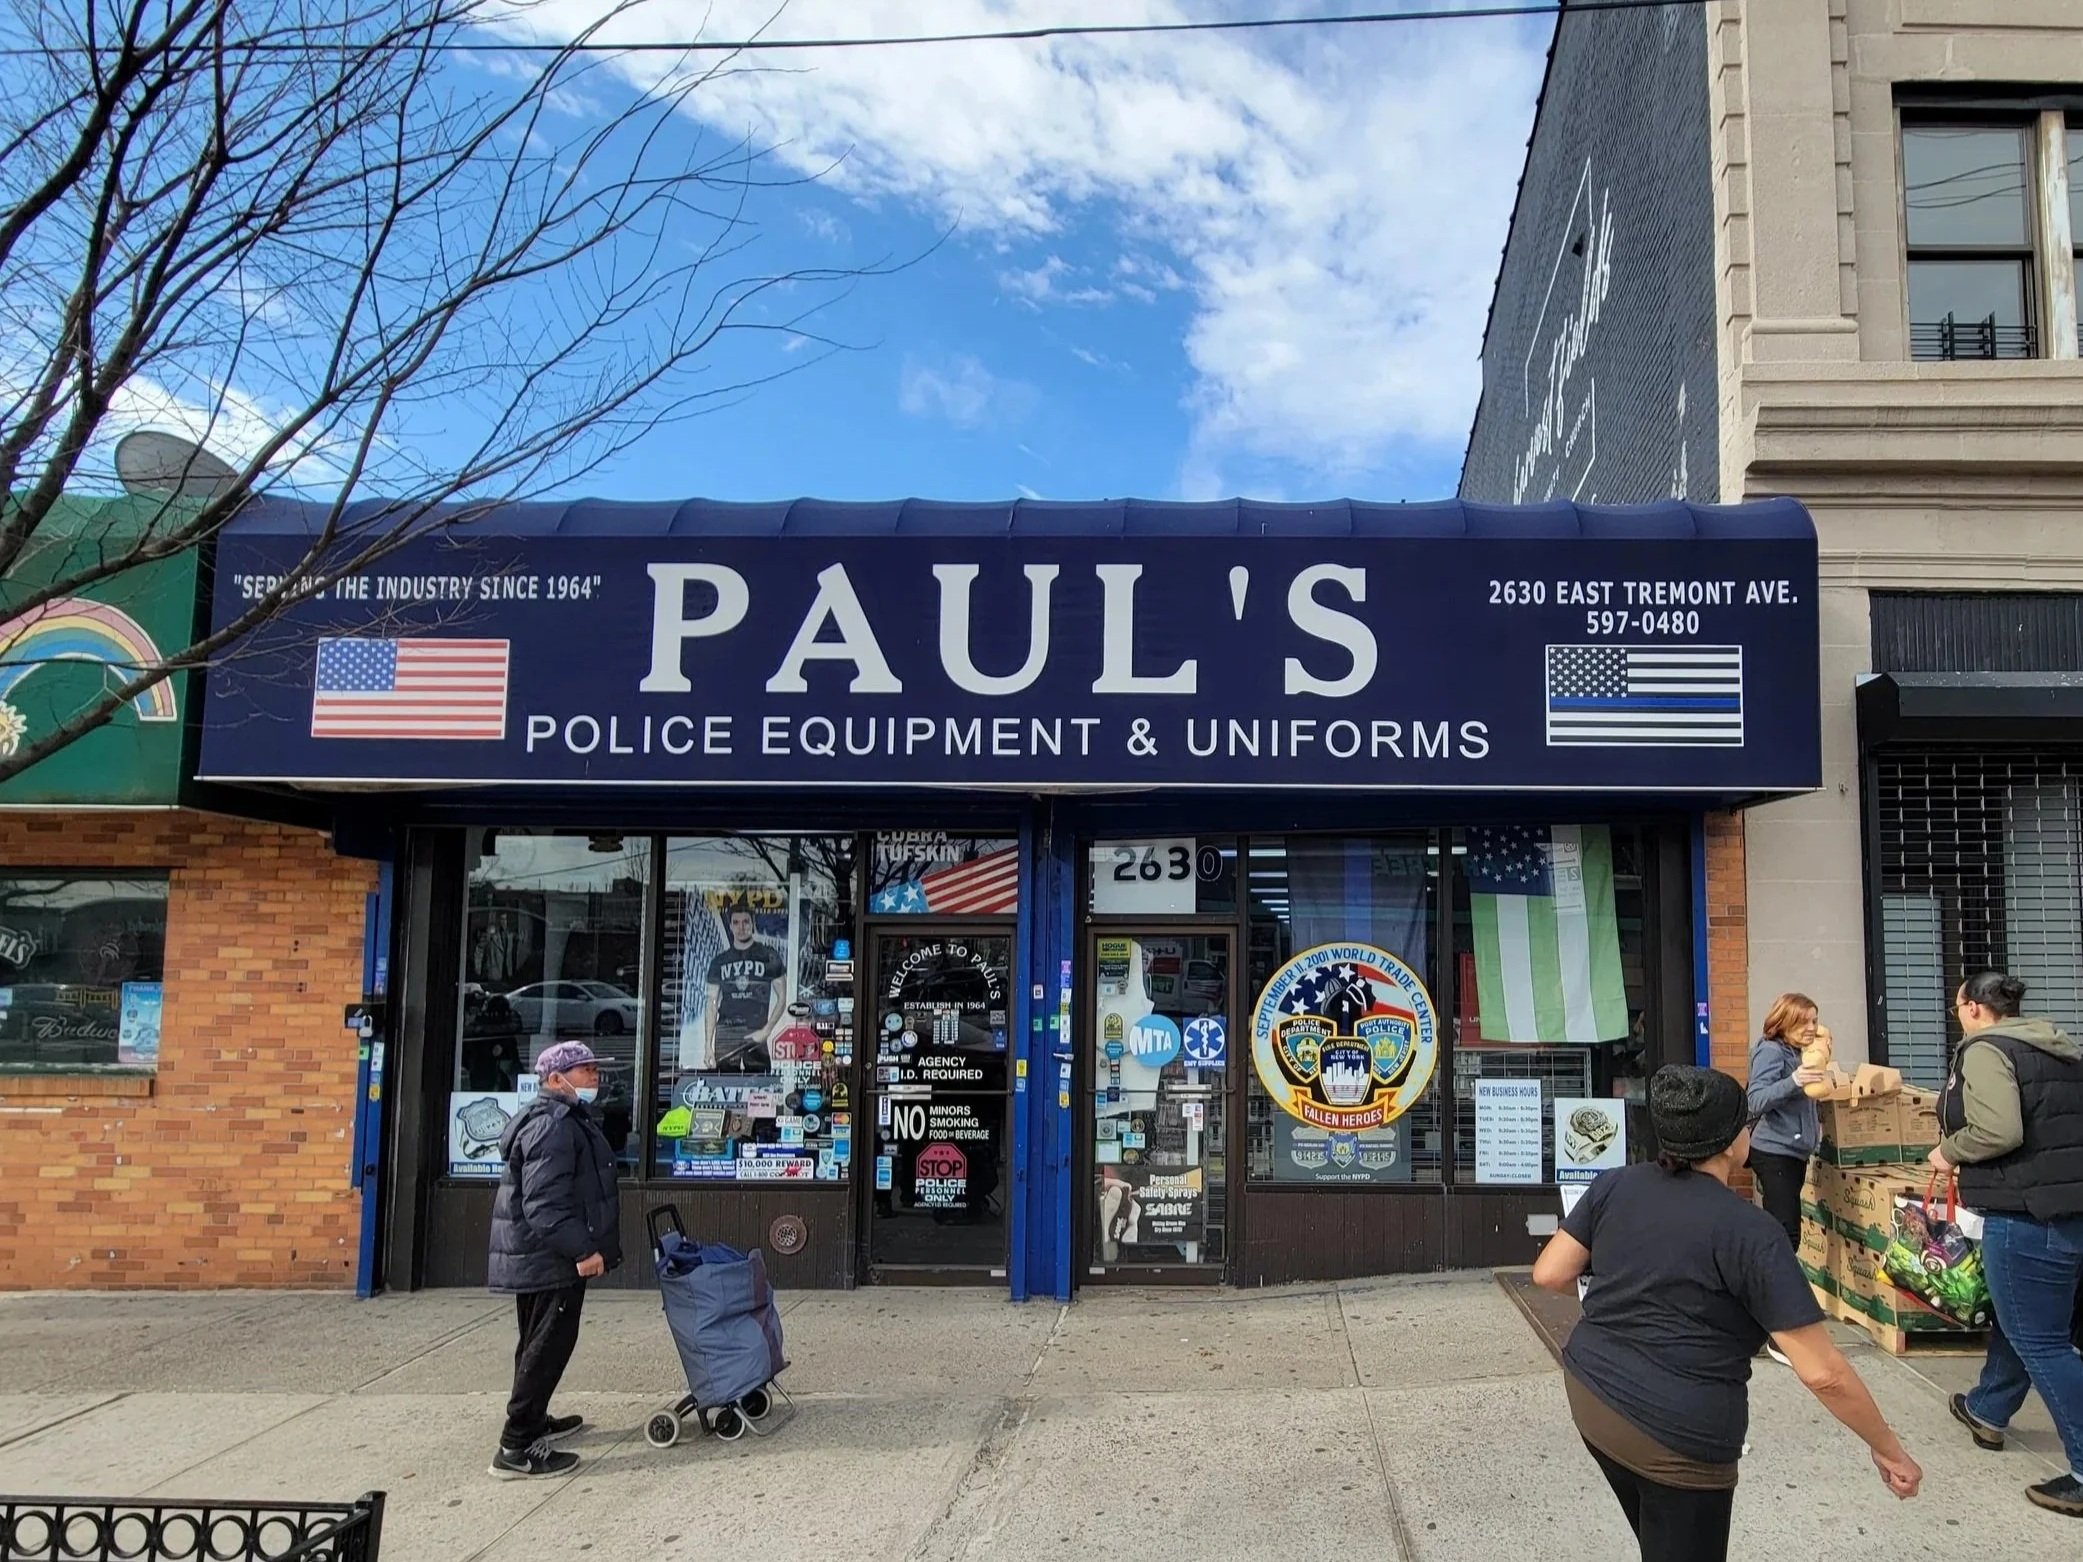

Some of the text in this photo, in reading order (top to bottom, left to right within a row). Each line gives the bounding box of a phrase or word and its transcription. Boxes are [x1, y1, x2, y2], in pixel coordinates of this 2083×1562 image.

[1566, 392, 1591, 458] CHURCH
[233, 574, 601, 600] "SERNG THE INDUSTRY SINCE 1964"
[1489, 580, 1798, 605] 2630 EAST TREMONT AVE.
[1587, 610, 1700, 635] 597-0480
[639, 562, 1379, 698] PAUL'S
[526, 715, 1491, 761] POLICE EQUIPMENT & UNIFORMS
[877, 831, 948, 842] COBRA
[1113, 845, 1223, 882] 2630
[705, 889, 783, 909] NYPD
[720, 960, 765, 980] NYPD
[889, 944, 1001, 1000] WELCOME TO PAUL'S
[1257, 973, 1296, 1040] SEPTEMBER
[1332, 948, 1377, 965] WORLD
[1380, 956, 1417, 992] TRADE
[1411, 991, 1433, 1044] CENTER
[903, 1001, 986, 1010] ESTABLISH IN 1964
[1360, 1019, 1410, 1030] PORT AUTHORITY
[1366, 1026, 1405, 1035] POLICE
[1281, 1026, 1331, 1038] DEPARTMENT
[1130, 1025, 1172, 1056] MTA
[1322, 1041, 1370, 1052] FIRE DEPARTMENT
[1283, 1045, 1294, 1063] CITY
[918, 1056, 967, 1068] AGENCY
[901, 1069, 983, 1080] I.D. REQUIRED
[1479, 1087, 1538, 1097] NEW BUSINESS HOURS
[929, 1106, 971, 1115] MINORS
[1304, 1105, 1383, 1127] FALLEN HEROES
[894, 1105, 926, 1140] NO
[929, 1117, 979, 1127] SMOKING
[929, 1130, 947, 1140] FOOD
[955, 1130, 989, 1140] BEVERAGE
[453, 1163, 491, 1174] Available
[738, 1160, 772, 1168] $10,000
[776, 1160, 812, 1168] REWARD
[919, 1160, 963, 1176] STOP
[1150, 1174, 1187, 1185] Personal
[1315, 1172, 1370, 1182] Support the NYPD
[1559, 1170, 1597, 1180] Available
[915, 1178, 967, 1187] POLICE
[1140, 1186, 1198, 1199] Safety Sprays
[1844, 1187, 1876, 1211] Squash
[1145, 1202, 1192, 1216] SABRE
[1803, 1231, 1825, 1254] Squash
[1847, 1256, 1879, 1281] Squash
